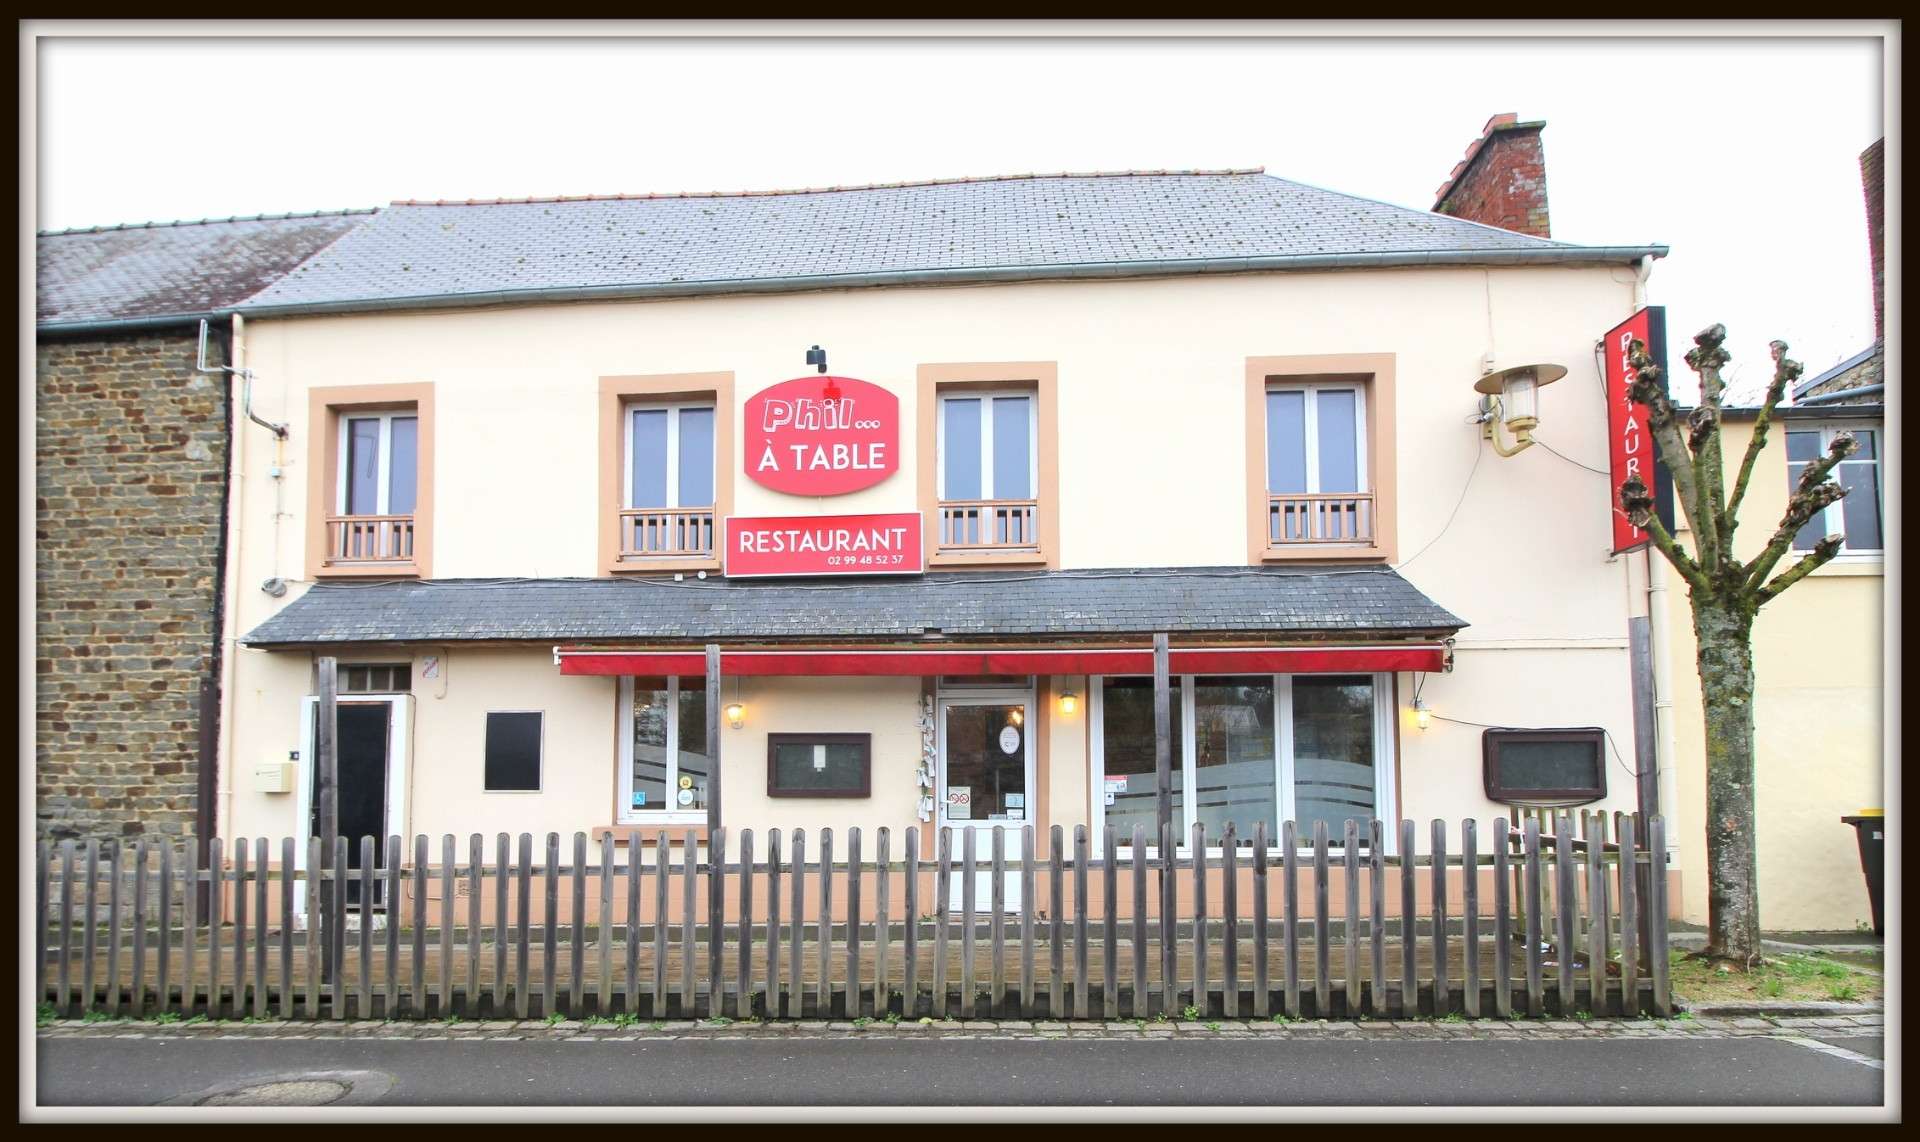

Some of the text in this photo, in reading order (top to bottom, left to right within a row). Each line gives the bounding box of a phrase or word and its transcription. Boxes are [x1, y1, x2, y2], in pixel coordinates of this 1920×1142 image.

[758, 439, 886, 471] À TABLE
[740, 528, 907, 552] RESTAURANT
[827, 554, 904, 566] 02 99 48 52 37
